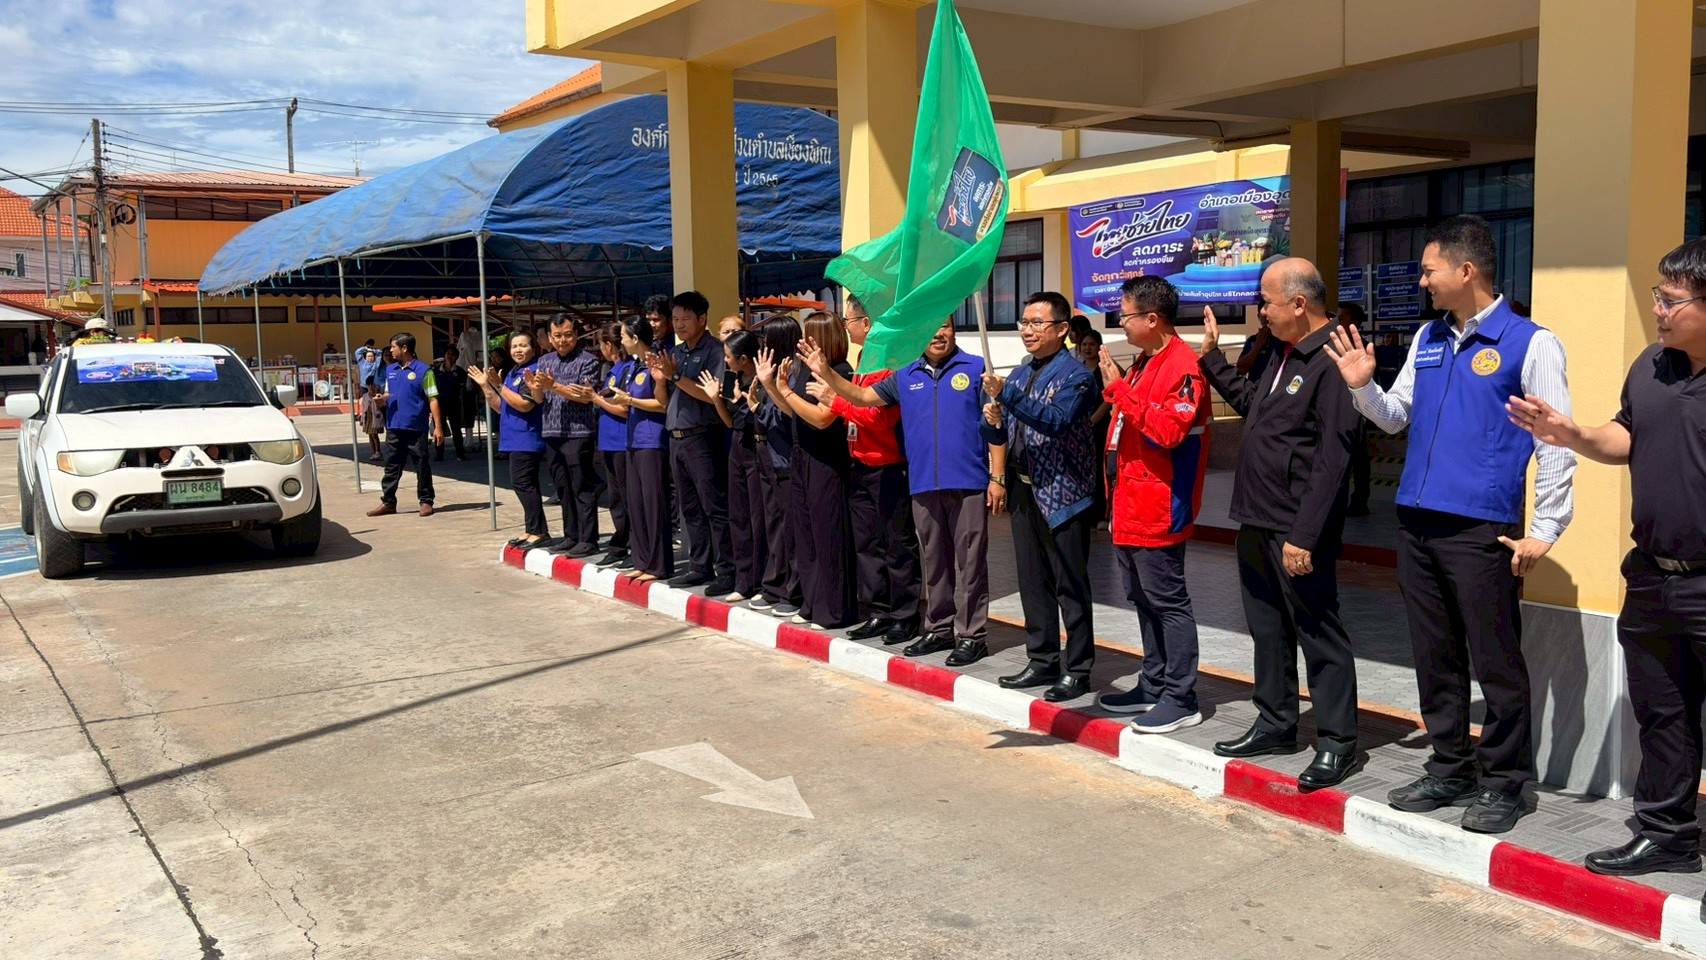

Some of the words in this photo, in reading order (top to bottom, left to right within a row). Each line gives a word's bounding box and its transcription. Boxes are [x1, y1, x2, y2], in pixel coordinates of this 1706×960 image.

[734, 127, 832, 165] ่วนตำบลเชียงพิณ
[752, 172, 779, 187] 2565
[1132, 243, 1184, 257] ลดภาระ
[1123, 255, 1174, 267] ลดค่าครองชีพ
[191, 481, 219, 493] 8484
